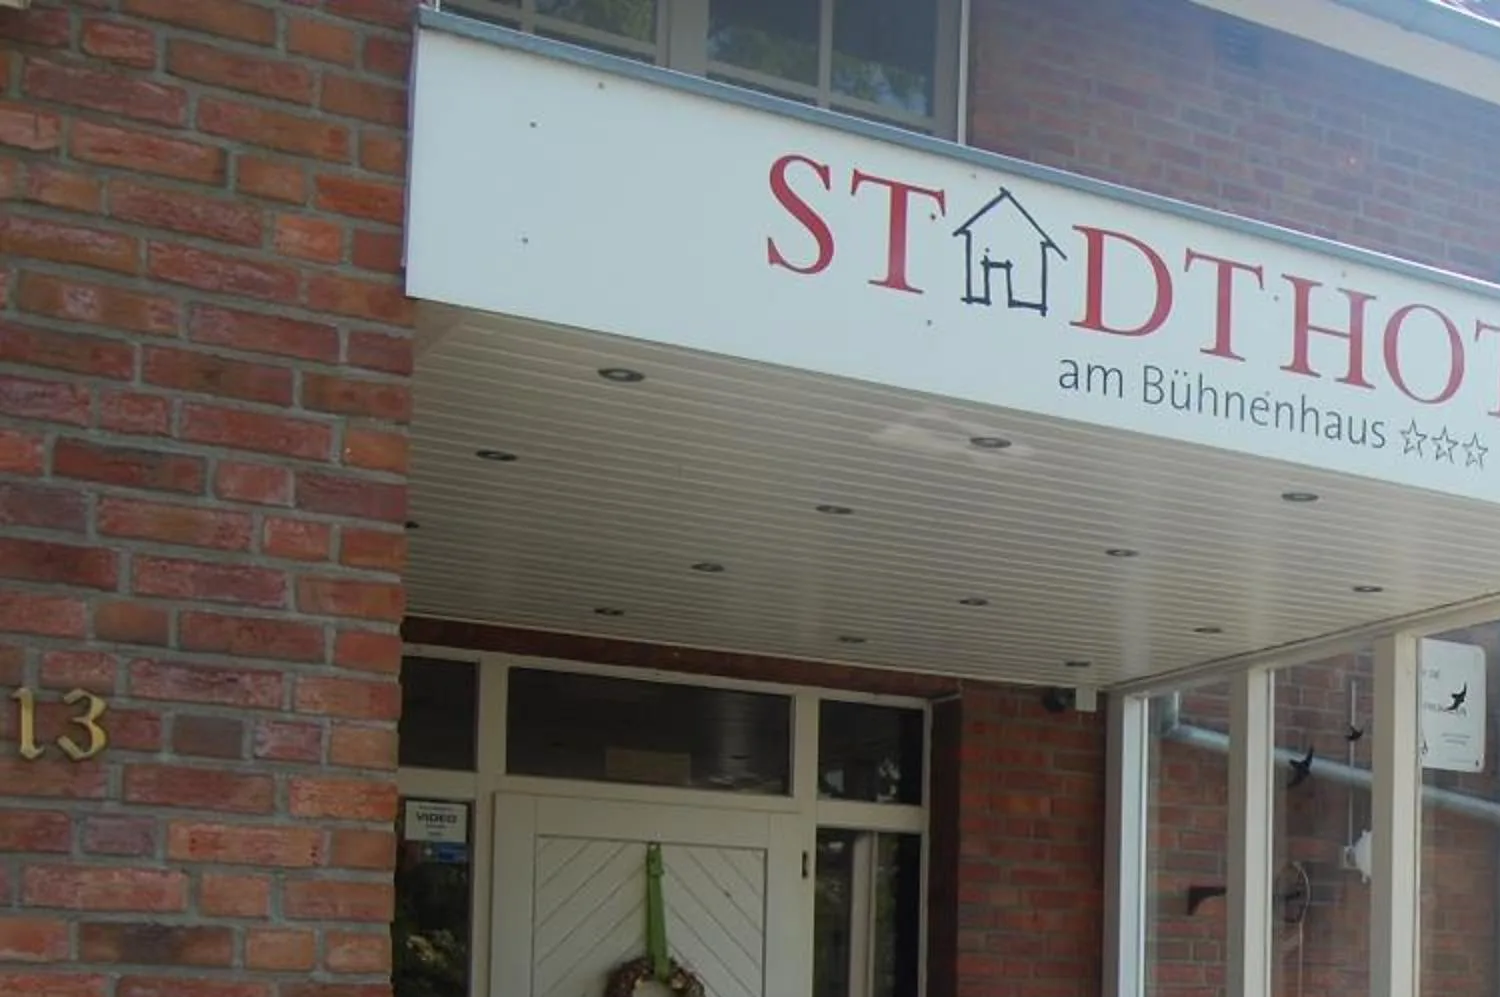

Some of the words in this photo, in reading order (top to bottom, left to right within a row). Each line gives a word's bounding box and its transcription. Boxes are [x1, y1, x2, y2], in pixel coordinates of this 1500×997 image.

[1058, 358, 1123, 399] am
[1142, 365, 1386, 449] Bühnenhaus
[10, 687, 106, 759] 13
